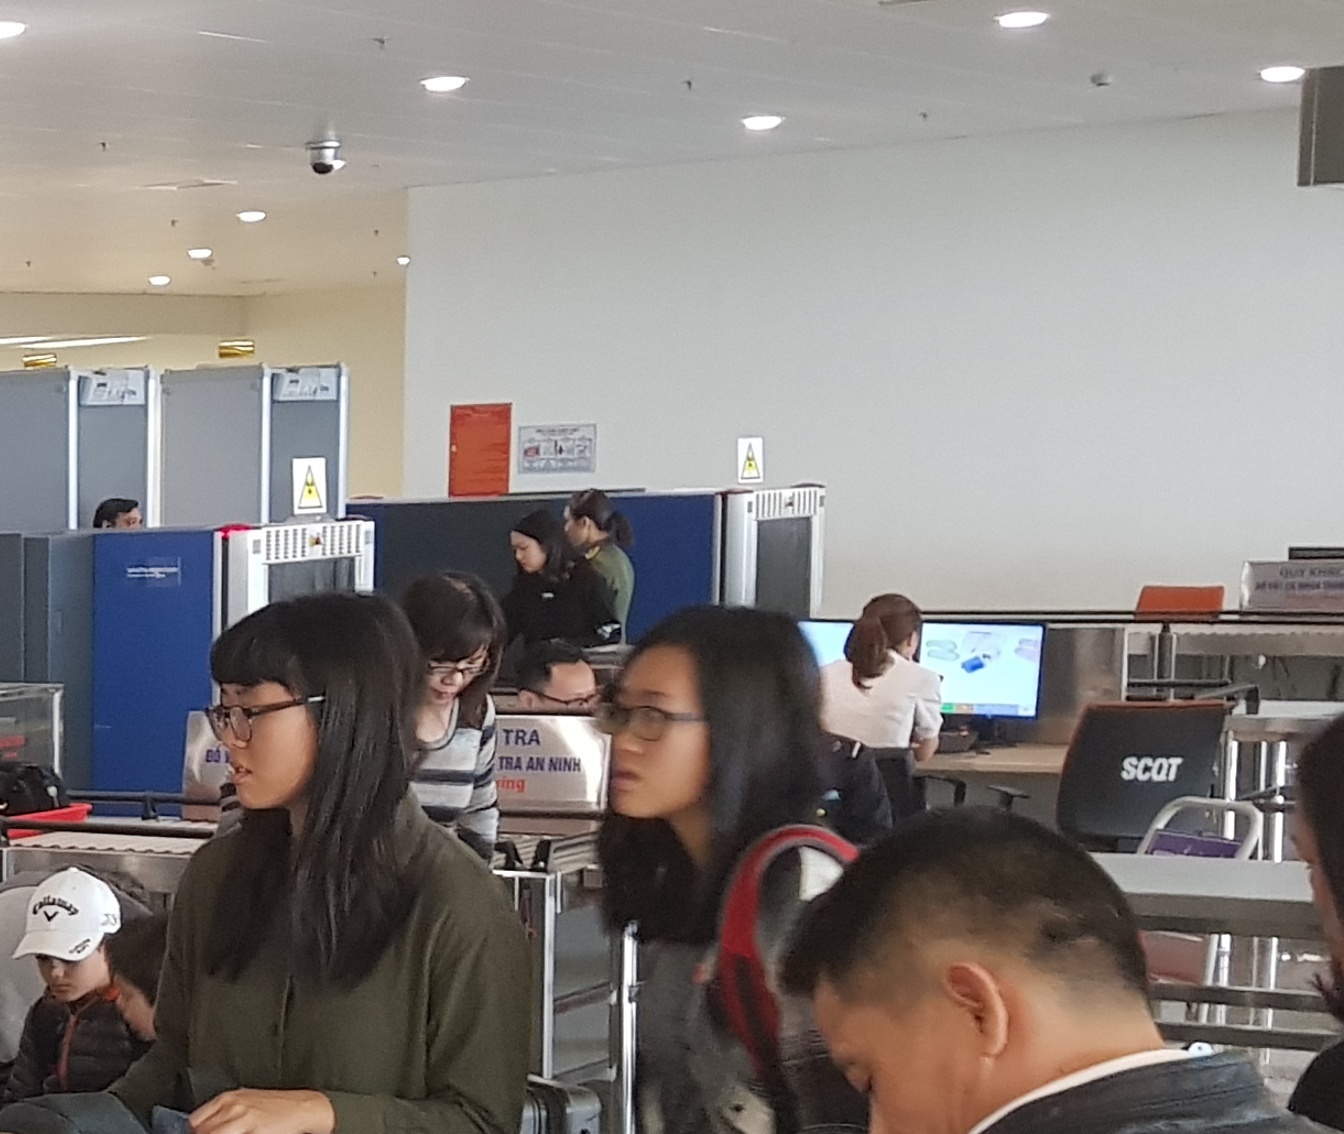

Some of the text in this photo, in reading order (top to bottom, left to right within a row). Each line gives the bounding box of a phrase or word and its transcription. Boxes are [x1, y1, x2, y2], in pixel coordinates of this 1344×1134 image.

[502, 728, 540, 747] TRA
[497, 756, 582, 773] TRA AN NINH
[1120, 755, 1184, 782] SCQT
[32, 895, 79, 916] Callaway
